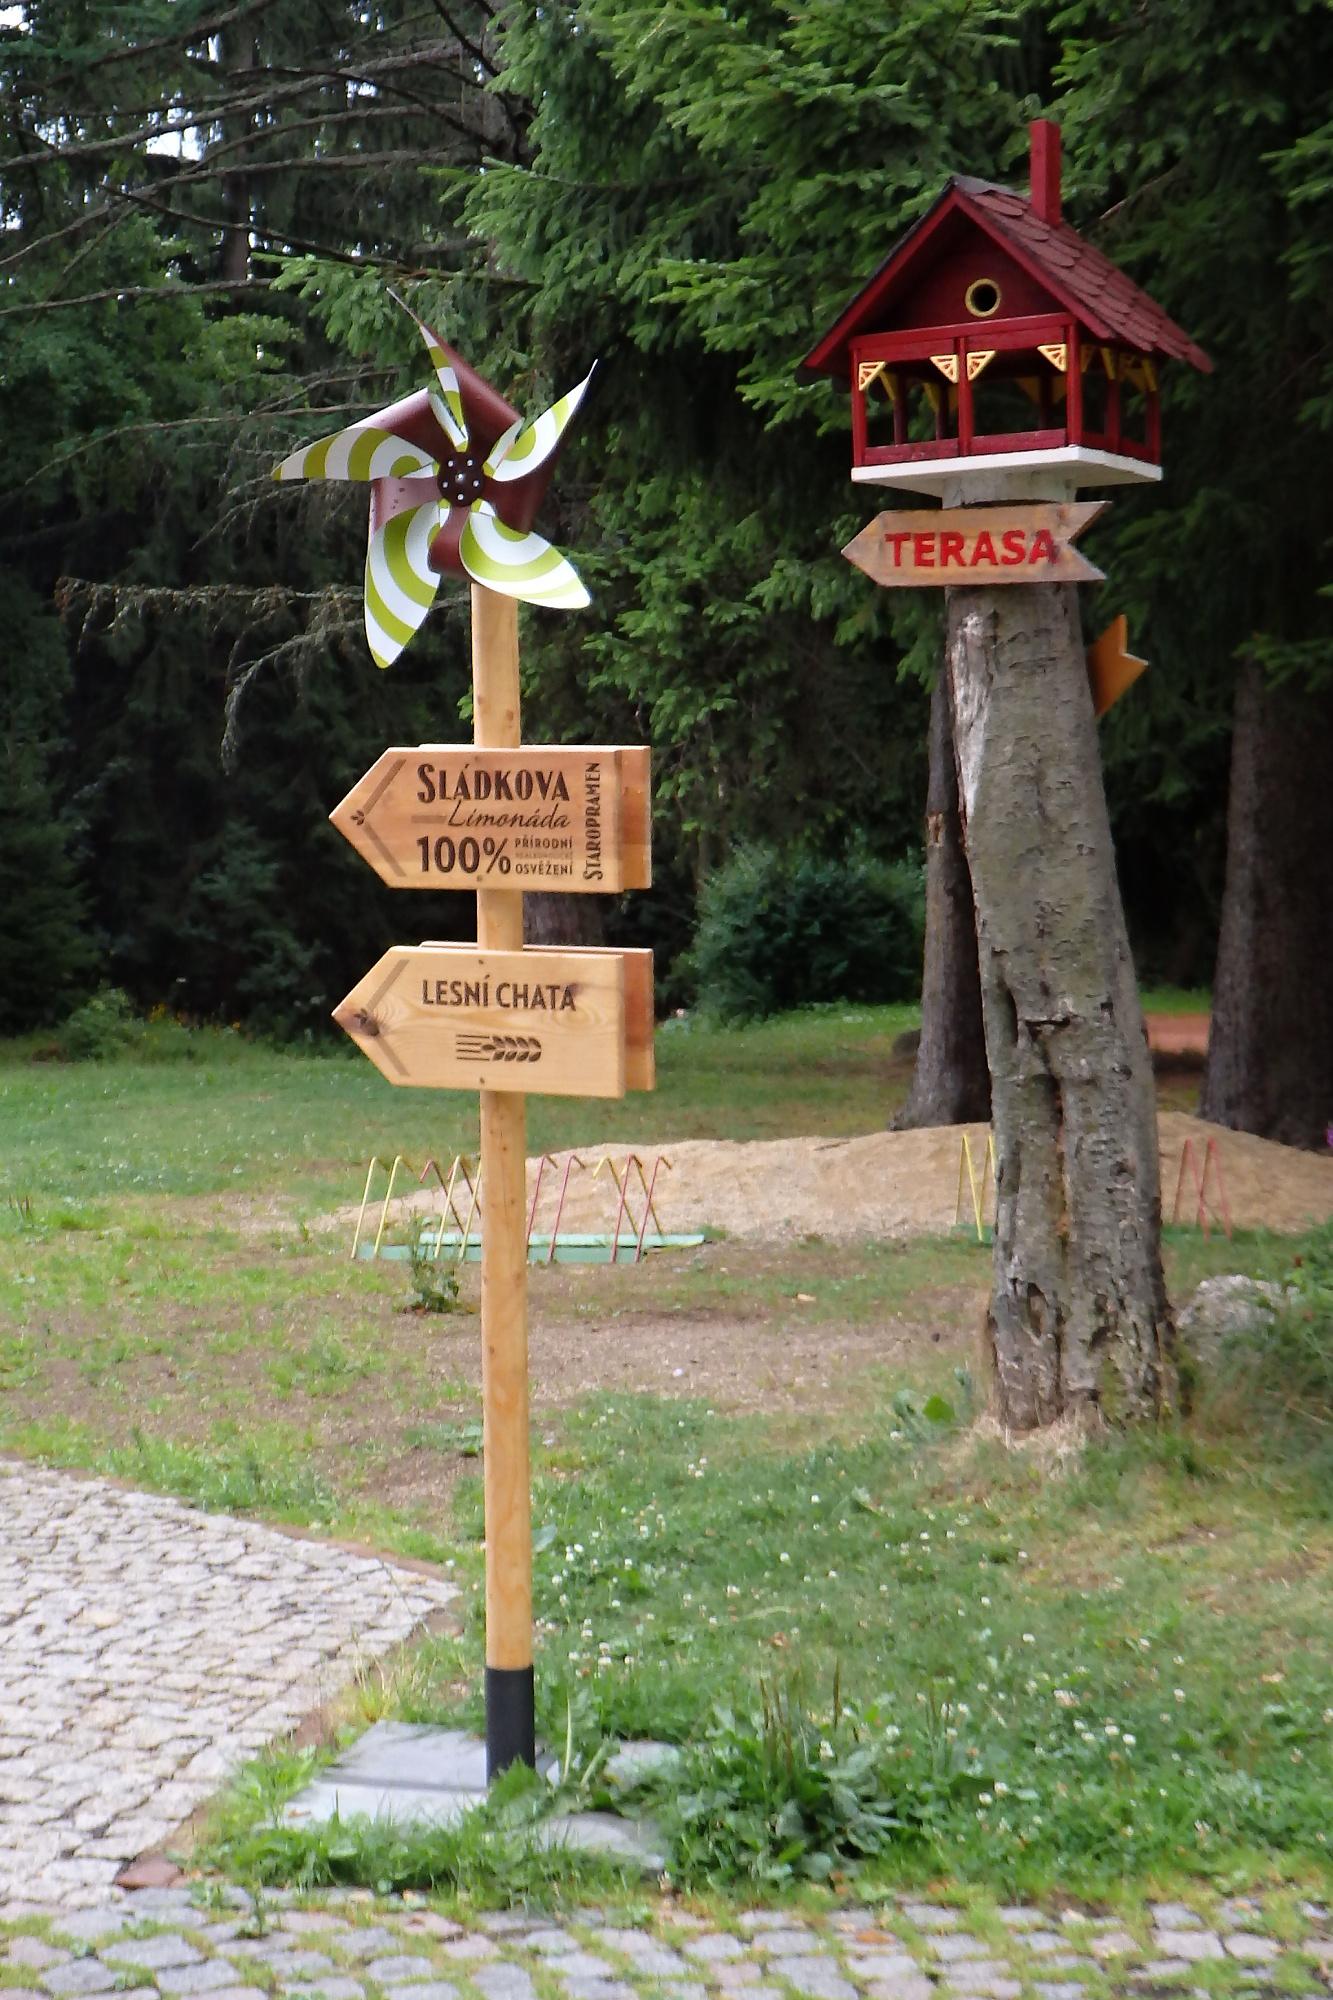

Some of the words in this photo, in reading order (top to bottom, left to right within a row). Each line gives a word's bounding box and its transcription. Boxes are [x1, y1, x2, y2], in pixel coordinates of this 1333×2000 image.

[884, 528, 1059, 568] TERASA
[417, 763, 571, 804] SLÁDKOVA
[447, 798, 571, 829] Limonáda
[582, 762, 604, 881] STAROPRAMEN
[416, 835, 511, 875] 100%
[514, 834, 573, 849] PŘÍRODNÍ
[514, 860, 573, 875] OSVĚŽENÍ
[421, 974, 489, 1006] LESNÍ
[495, 983, 577, 1012] CHATA
